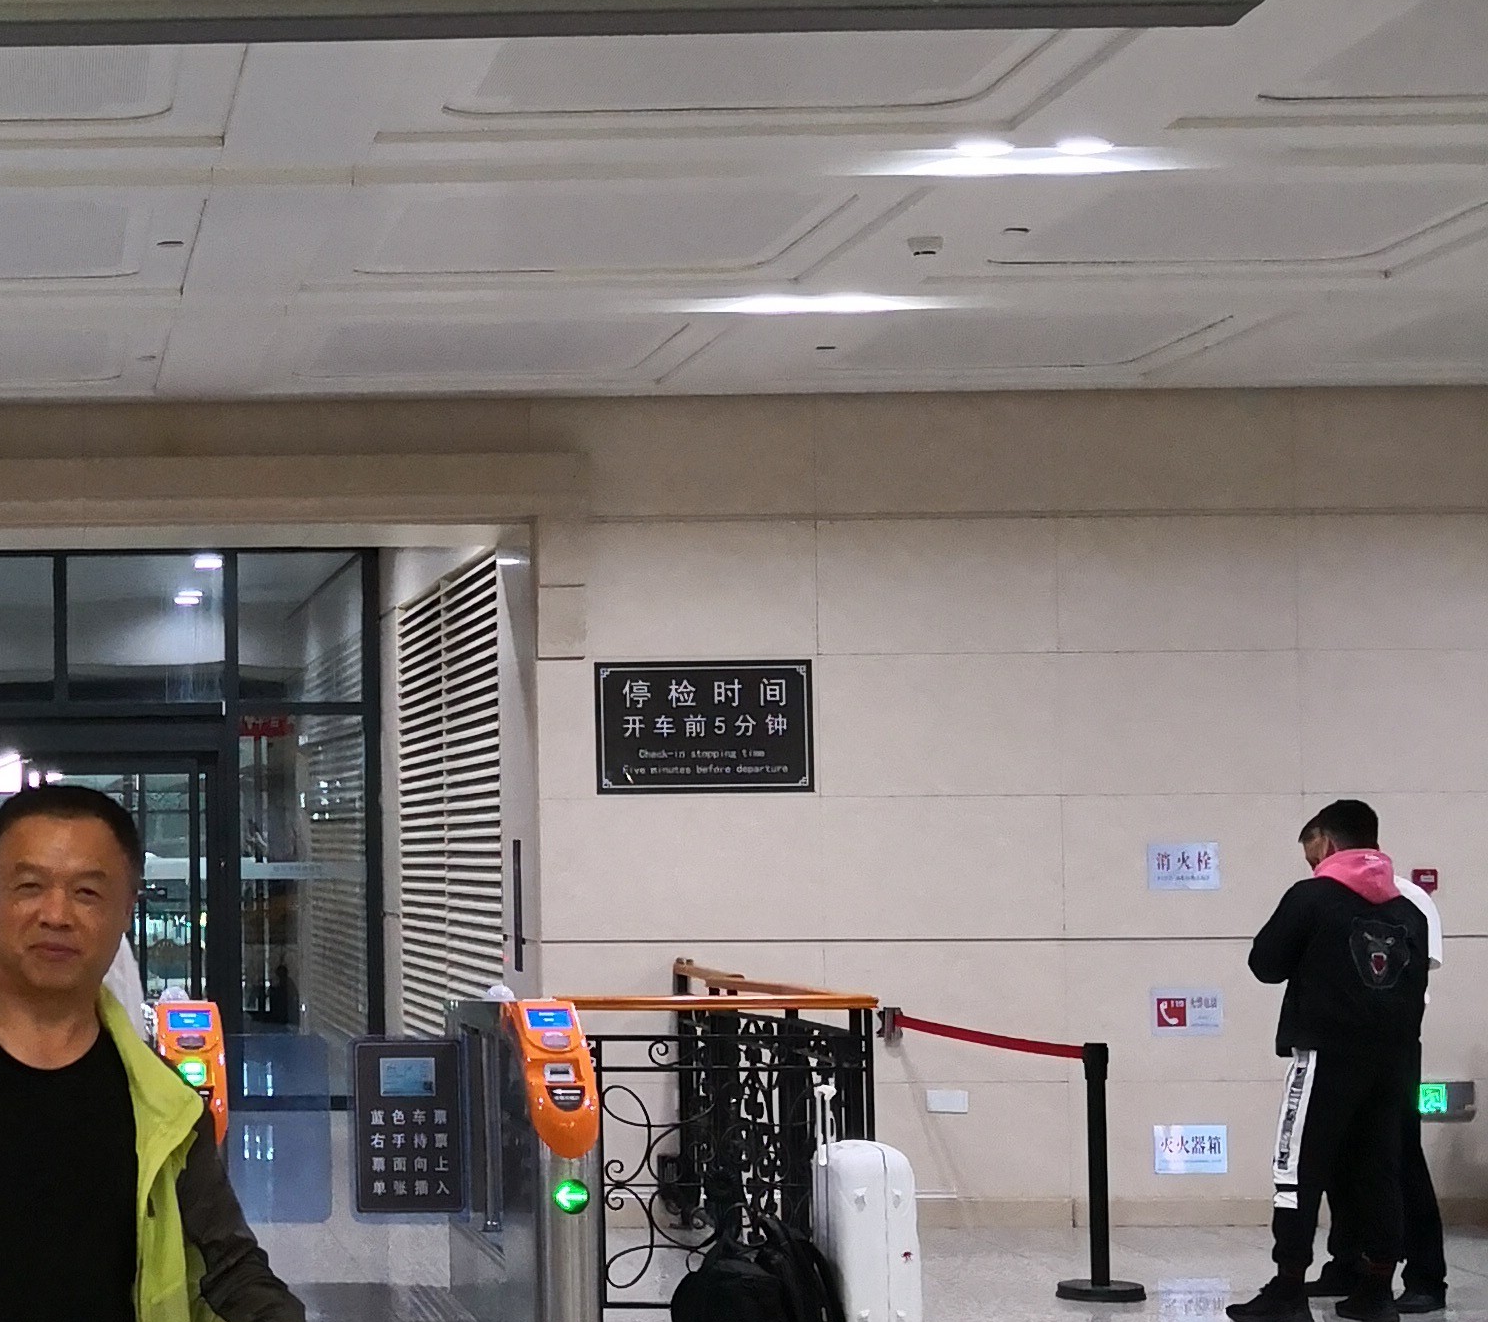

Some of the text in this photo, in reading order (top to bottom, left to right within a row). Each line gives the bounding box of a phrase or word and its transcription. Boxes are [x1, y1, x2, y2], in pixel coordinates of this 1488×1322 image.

[622, 678, 787, 708] 停检时间
[622, 713, 788, 738] 开车前5分钟
[638, 748, 686, 760] Check-in
[741, 748, 766, 759] time
[650, 765, 692, 775] minutes
[696, 764, 731, 775] before
[736, 764, 789, 776] departure
[370, 1108, 448, 1126] 蓝色车票
[370, 1132, 448, 1149] 右手持票
[372, 1156, 450, 1172] 票面向上
[373, 1180, 450, 1196] 单张插入
